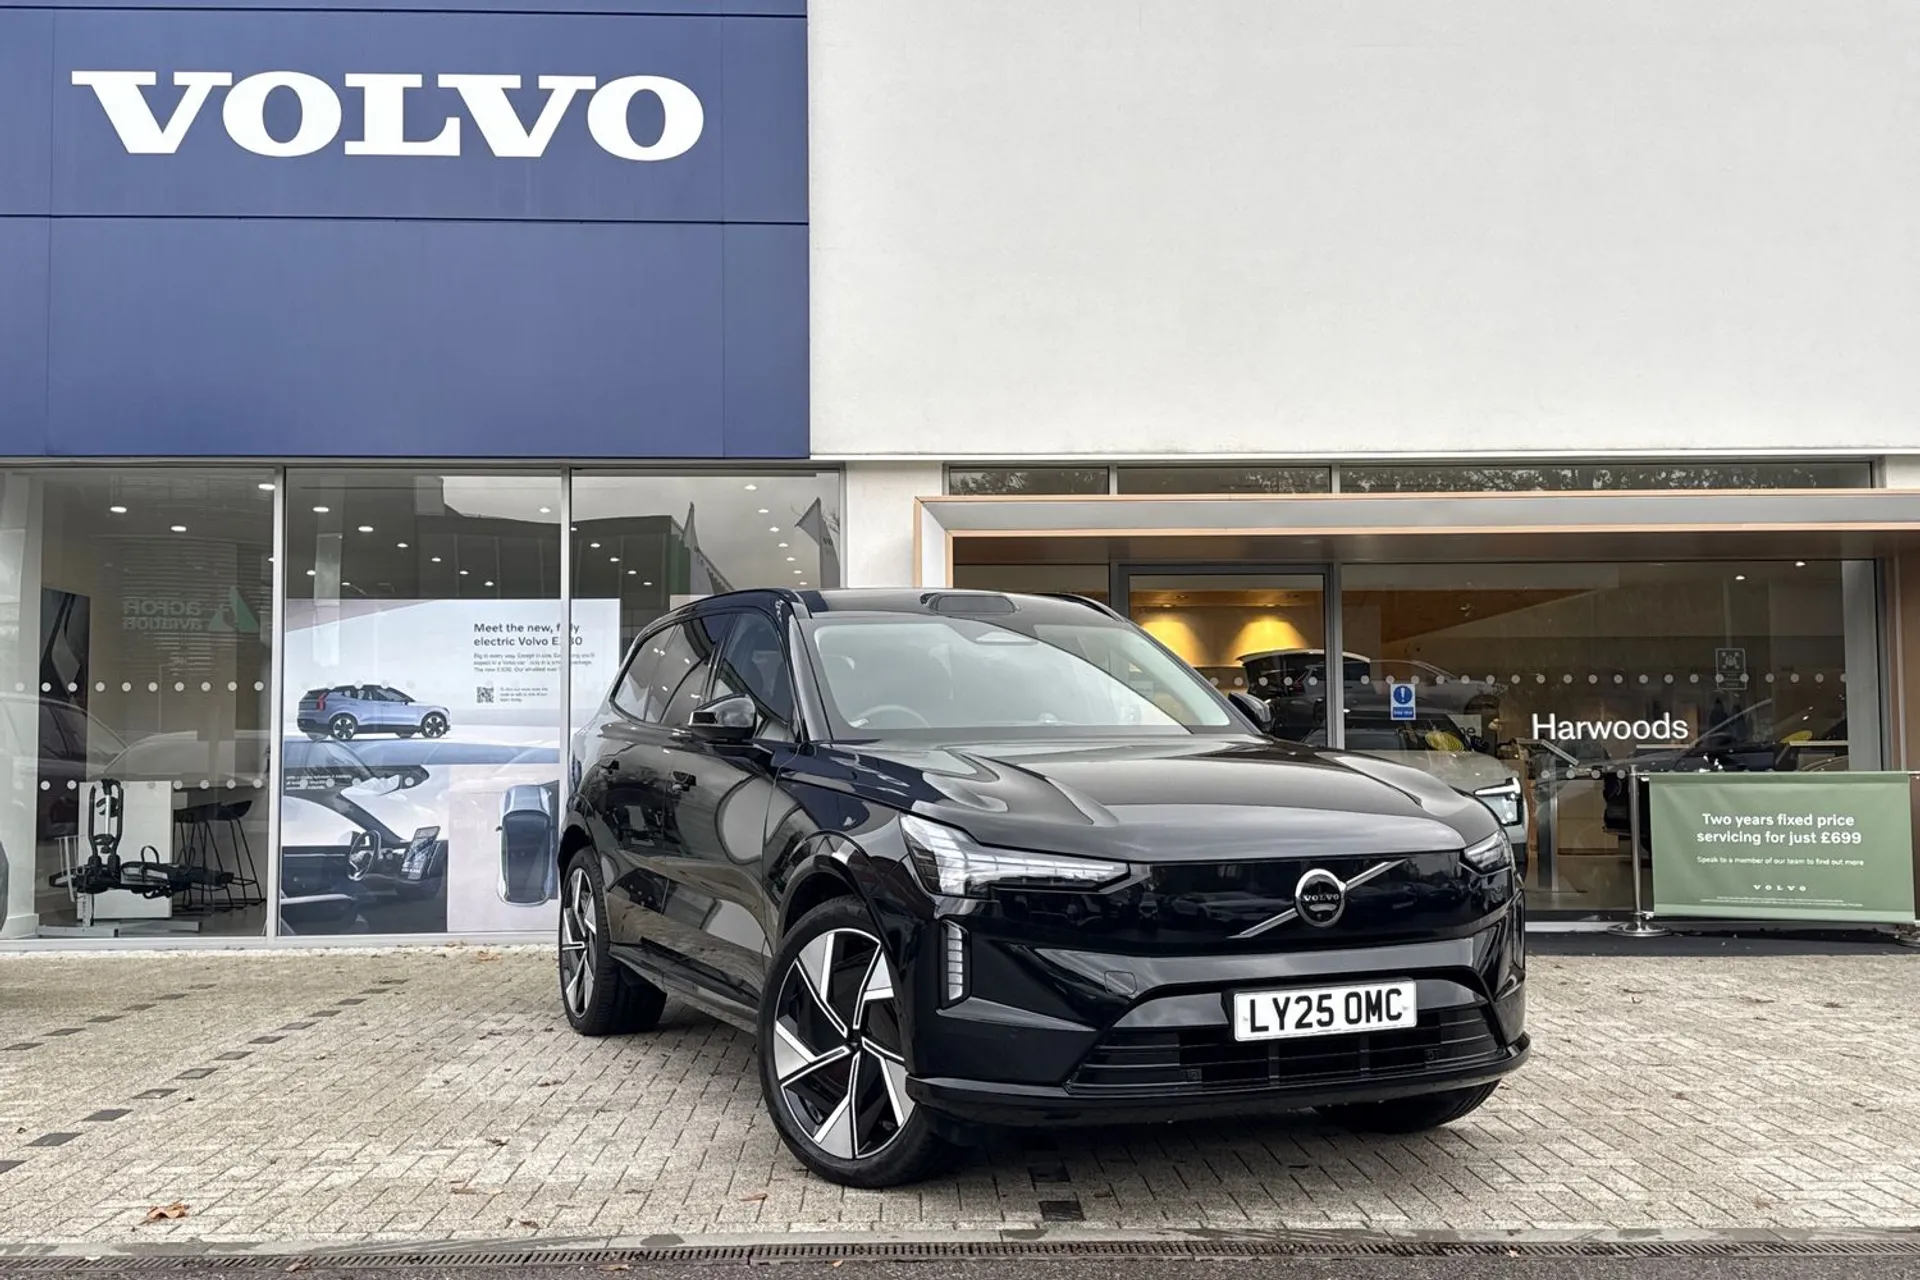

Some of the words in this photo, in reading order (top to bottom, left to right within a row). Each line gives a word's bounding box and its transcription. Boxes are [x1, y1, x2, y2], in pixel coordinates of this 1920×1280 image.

[71, 70, 704, 161] VOLVO
[474, 623, 503, 632] Meet
[506, 623, 524, 632] the
[527, 624, 553, 634] new,
[473, 636, 516, 646] electric
[518, 636, 548, 646] Volvo
[551, 636, 583, 646] E30
[1532, 712, 1689, 740] Harwoods
[1702, 813, 1732, 826] Two
[1735, 815, 1774, 828] years
[1777, 813, 1813, 826] fixed
[1817, 814, 1855, 828] price
[1696, 831, 1761, 846] servicing
[1765, 831, 1786, 843] for
[1788, 831, 1817, 846] just
[1820, 831, 1862, 844] £699
[1697, 856, 1718, 864] Speak
[1816, 858, 1830, 866] find
[1303, 893, 1340, 902] VOLVO
[1250, 994, 1334, 1033] LY25
[1344, 988, 1402, 1025] OMC
